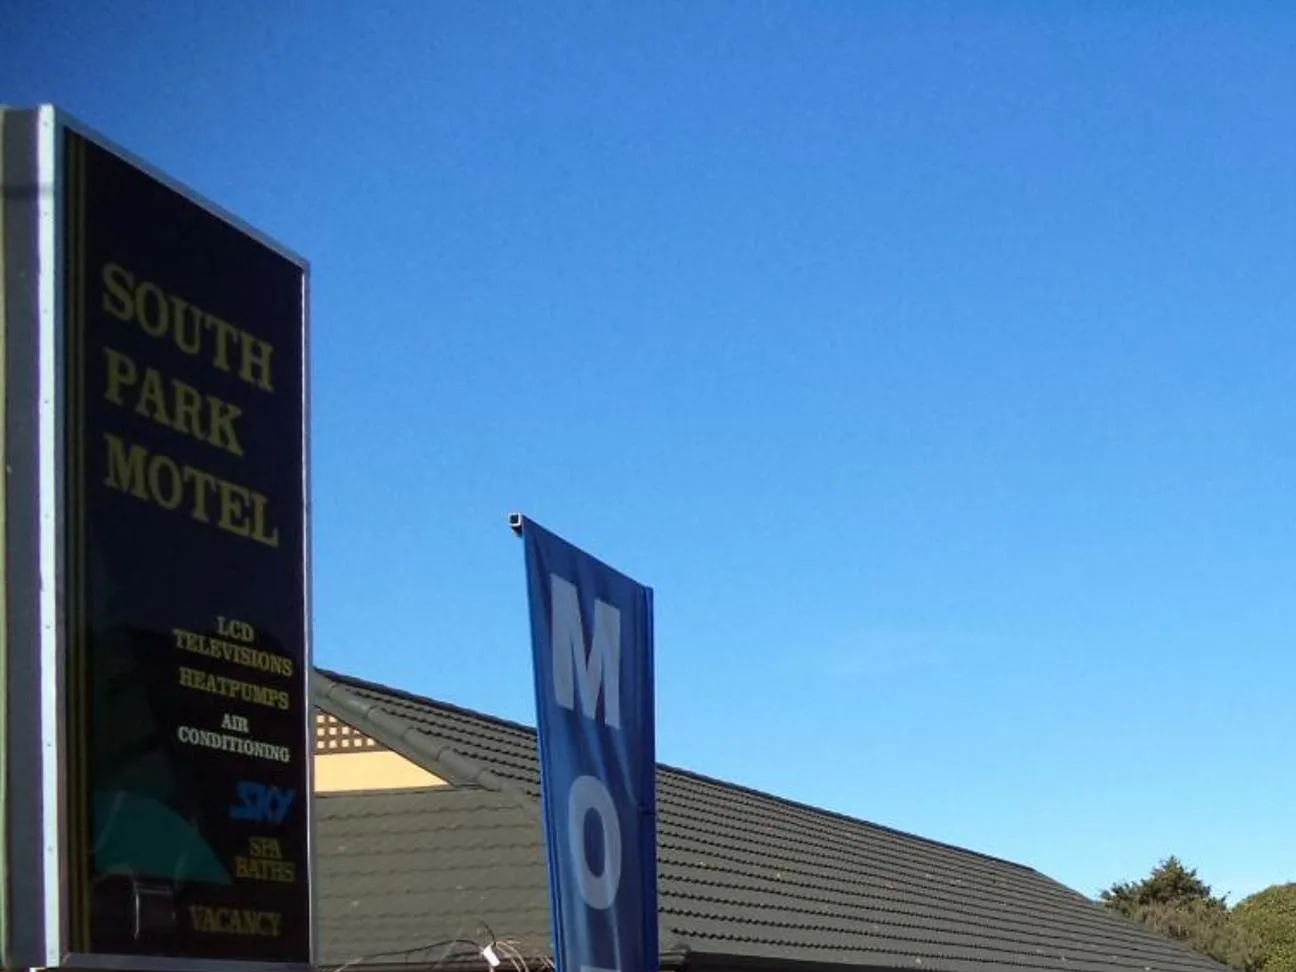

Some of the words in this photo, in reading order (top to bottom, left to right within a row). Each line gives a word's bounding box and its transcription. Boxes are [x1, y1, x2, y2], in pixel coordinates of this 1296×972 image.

[103, 262, 274, 392] SOUTH
[103, 347, 243, 456] PARK
[103, 433, 279, 547] MOTEL
[217, 616, 254, 642] LCD
[173, 628, 293, 677] TELEVISIONS
[179, 667, 289, 710] HEATPUMPS
[221, 713, 249, 733] AIR
[177, 726, 290, 763] CONDITIONING
[228, 781, 295, 825] SKY
[248, 836, 283, 859] SPA
[234, 856, 296, 883] BATHS
[189, 904, 283, 936] VACANCY
